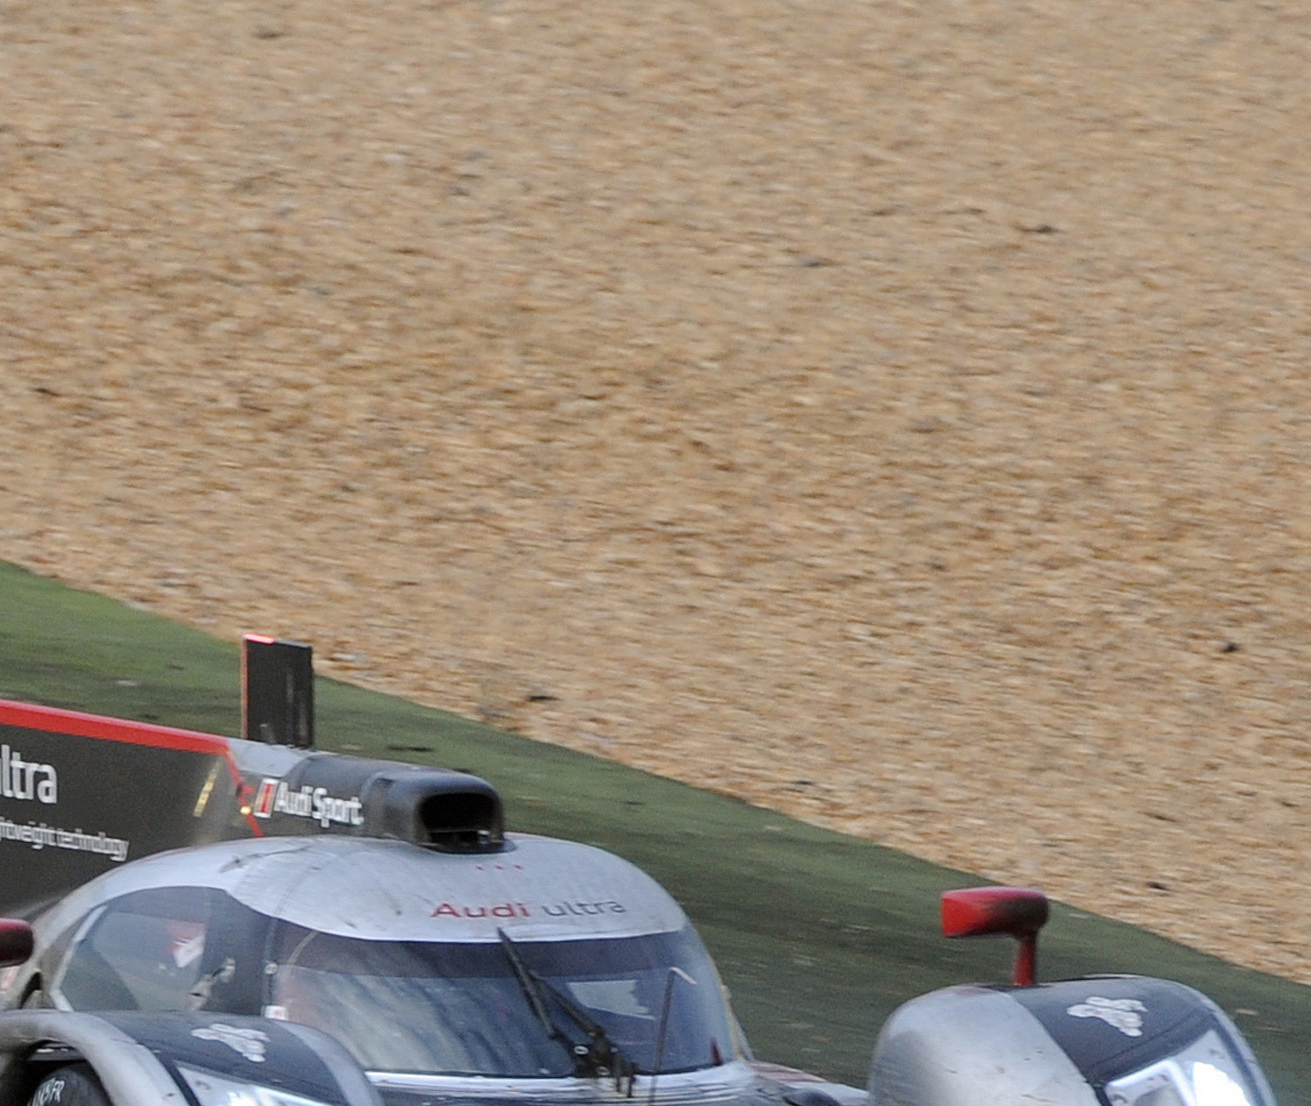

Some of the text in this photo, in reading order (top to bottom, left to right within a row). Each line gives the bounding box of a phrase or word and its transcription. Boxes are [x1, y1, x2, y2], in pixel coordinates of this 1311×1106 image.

[274, 782, 365, 828] Audi Sport
[430, 900, 628, 918] Audi ultra
